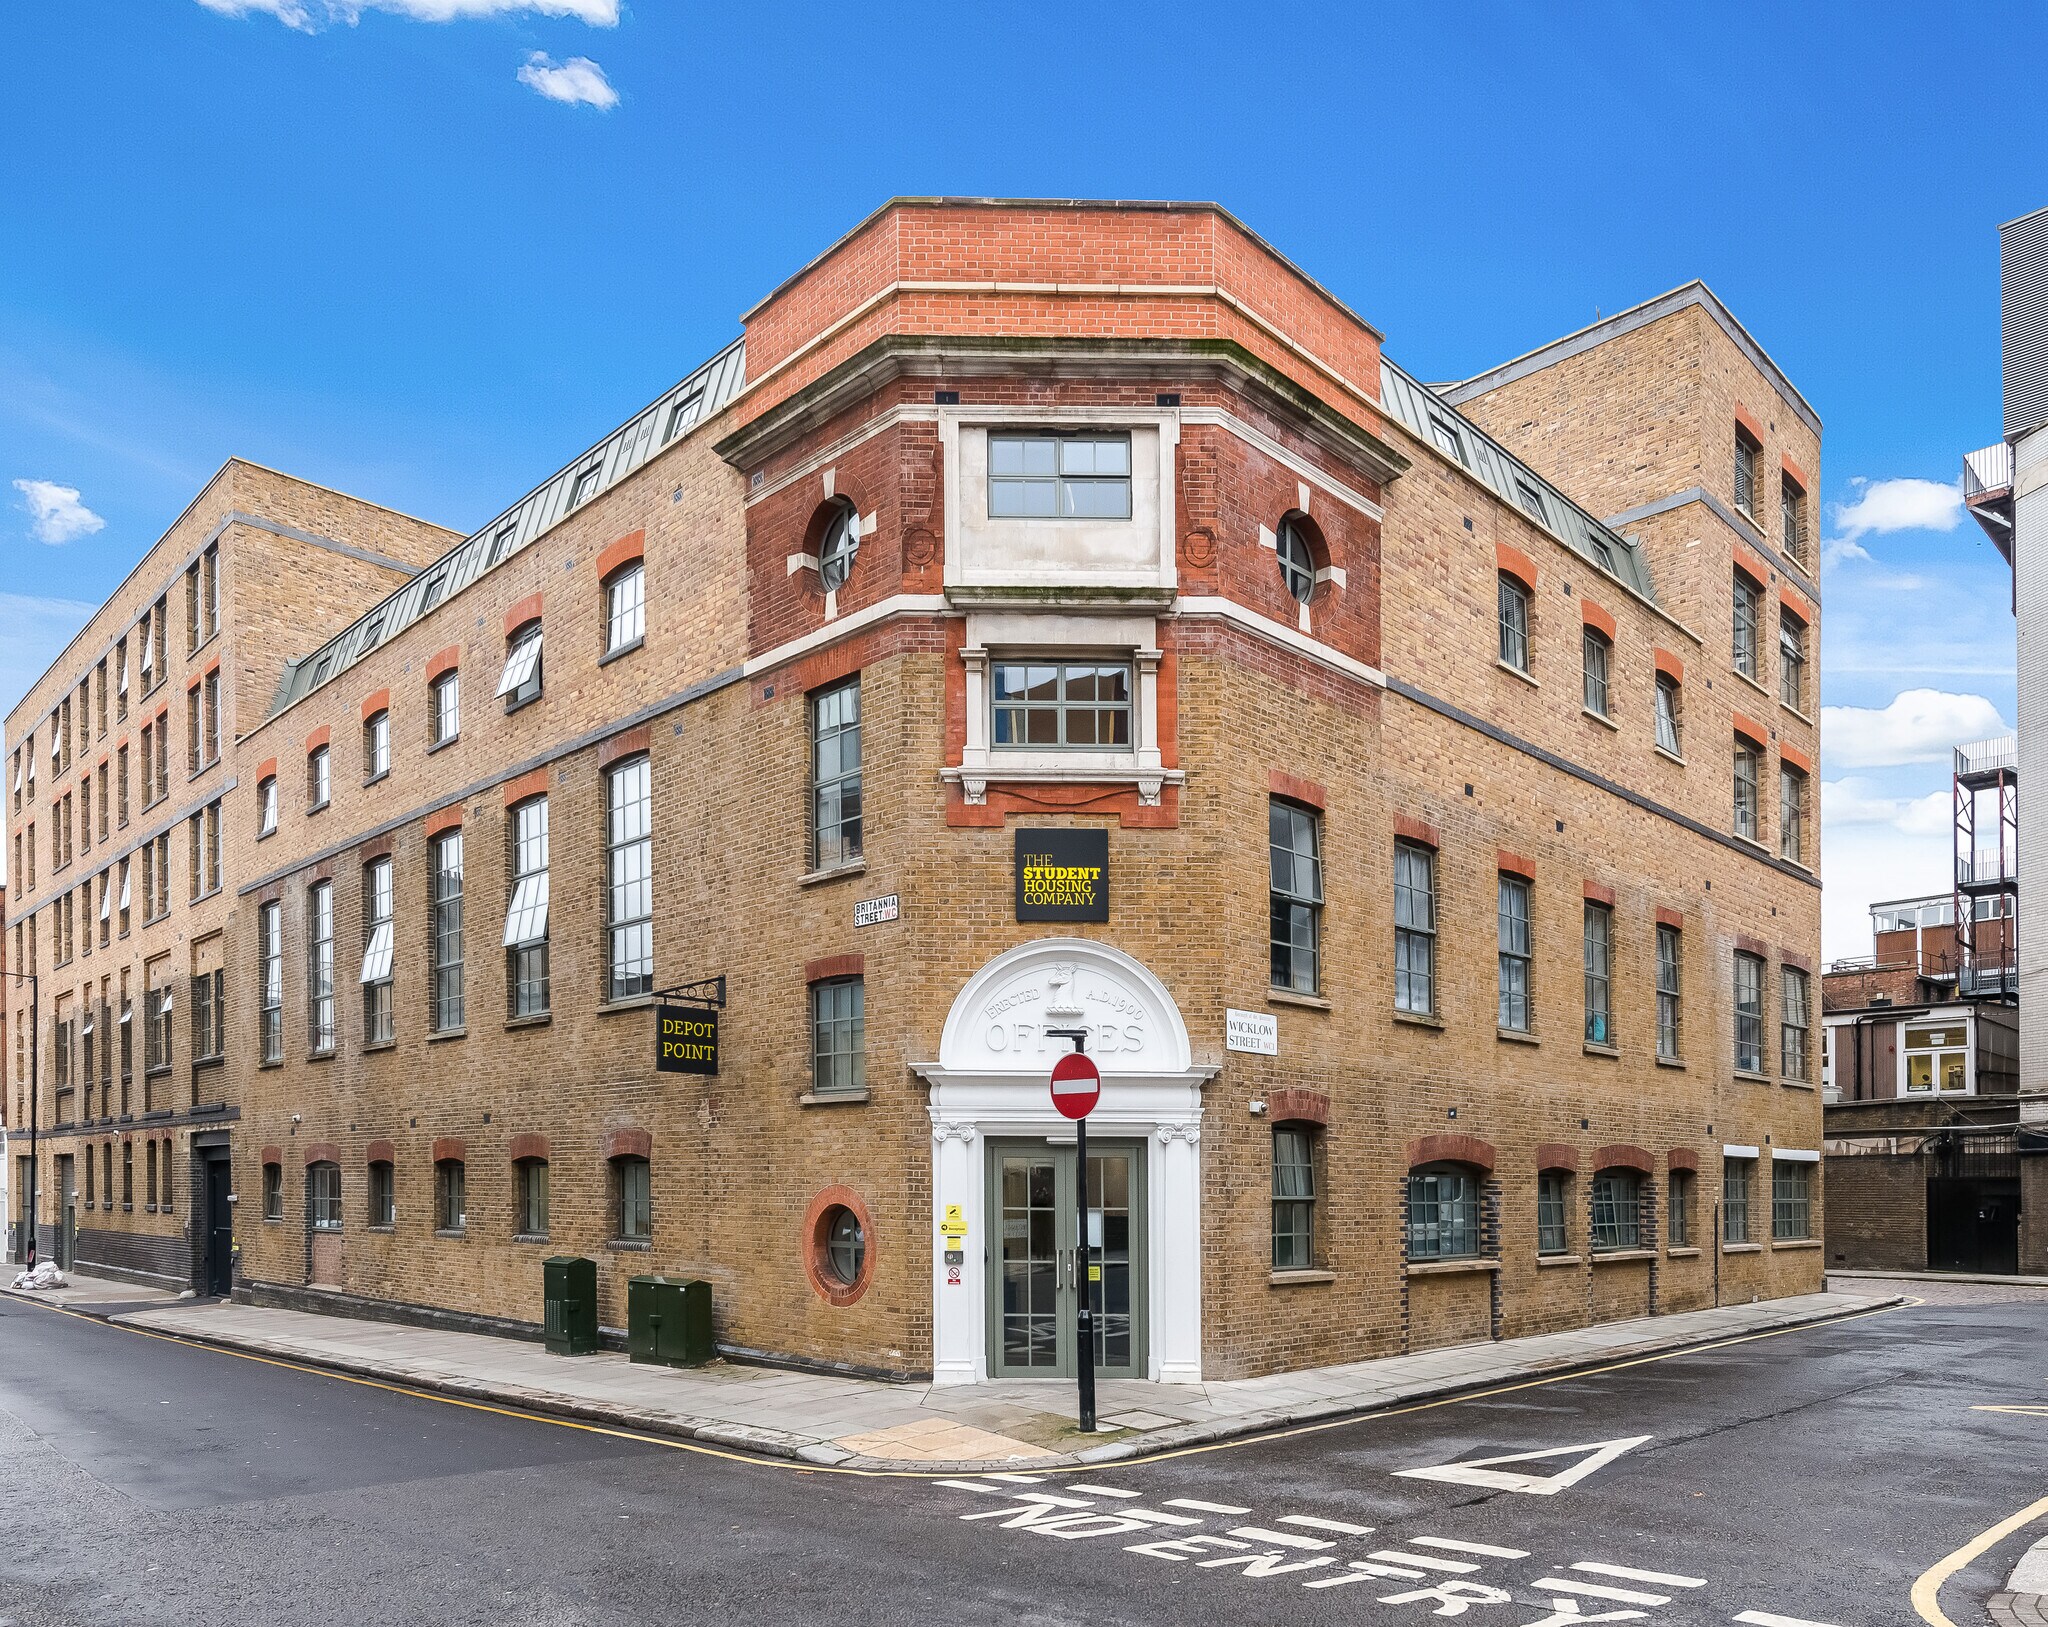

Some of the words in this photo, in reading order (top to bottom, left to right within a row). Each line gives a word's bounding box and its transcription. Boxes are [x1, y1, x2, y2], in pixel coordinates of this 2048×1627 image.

[1023, 853, 1053, 867] THE
[1023, 866, 1101, 880] STUDENT
[1023, 879, 1092, 893] HOUSING
[855, 896, 896, 915] BRITANNIA
[1023, 892, 1097, 906] COMPANY
[984, 988, 1041, 1020] ERECTED
[662, 1018, 715, 1038] DEPOT
[1228, 1020, 1274, 1036] WICKLOW
[1228, 1034, 1262, 1049] STREET
[662, 1041, 715, 1061] POINT
[958, 1503, 1154, 1540] NO
